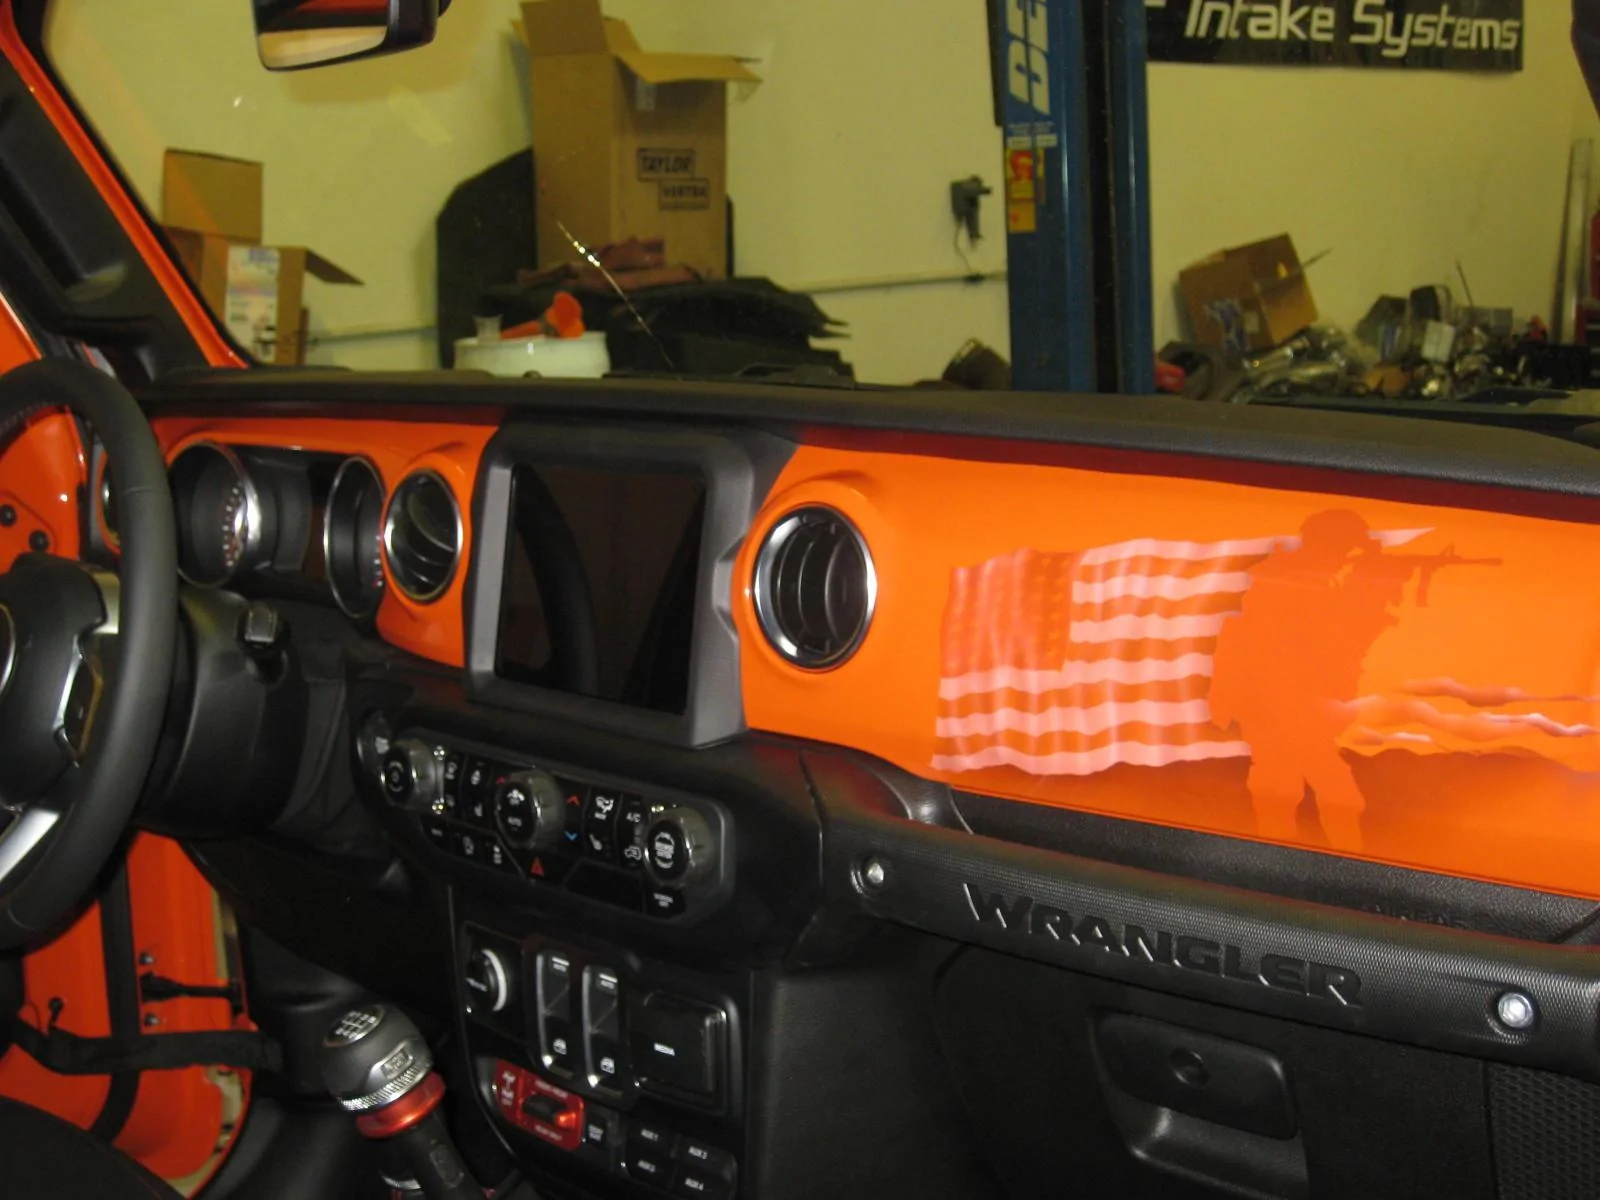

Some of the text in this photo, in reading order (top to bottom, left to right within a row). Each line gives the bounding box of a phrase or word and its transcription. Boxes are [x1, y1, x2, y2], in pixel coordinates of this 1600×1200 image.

[1184, 0, 1521, 58] Intake Systems
[640, 155, 693, 173] TAYLOR
[962, 882, 1363, 1008] WRANGLER
